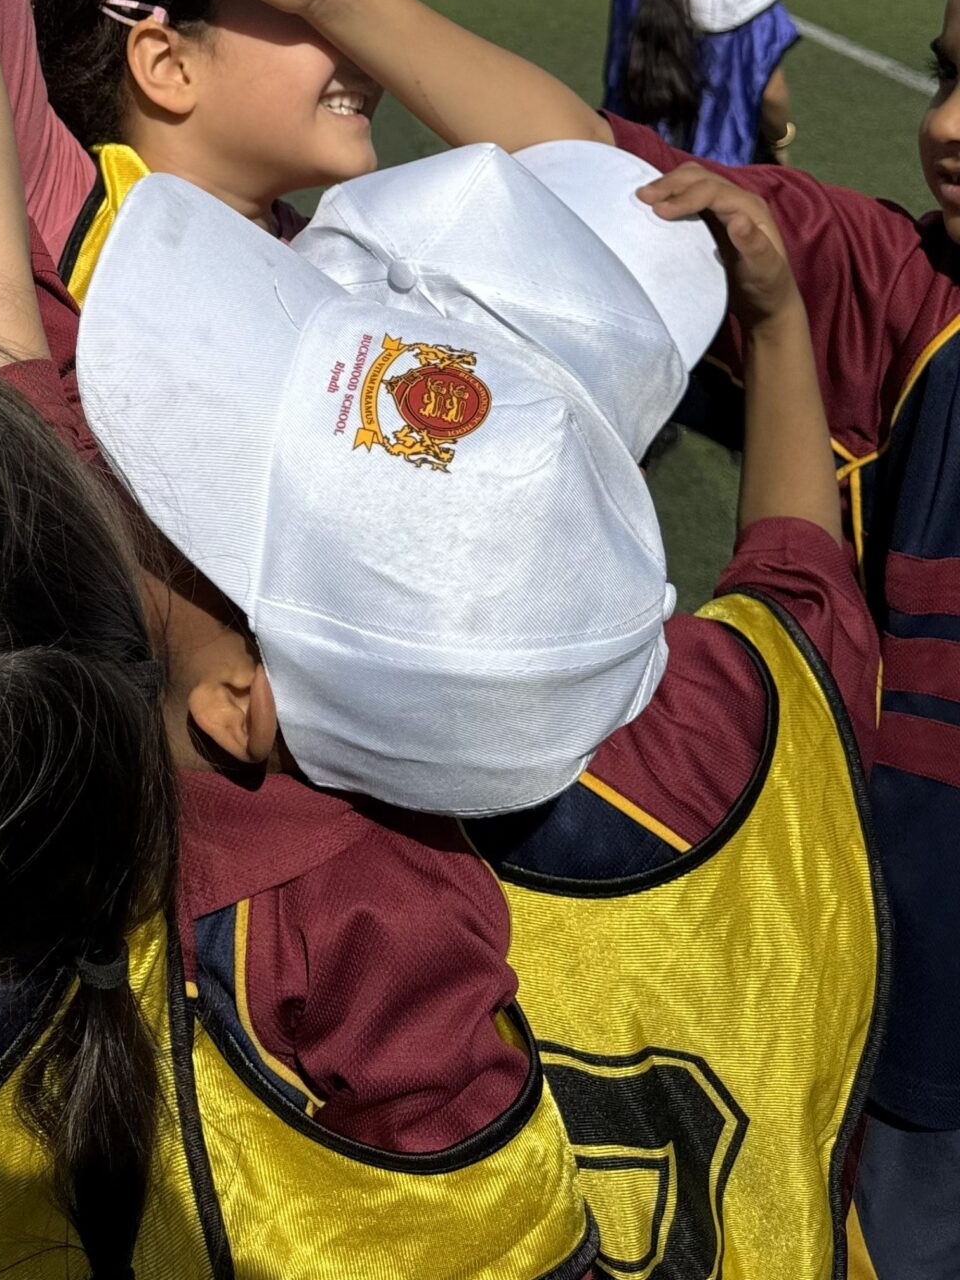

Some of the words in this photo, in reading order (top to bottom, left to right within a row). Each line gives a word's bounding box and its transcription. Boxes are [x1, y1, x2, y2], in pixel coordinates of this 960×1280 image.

[347, 334, 373, 391] BUCKSWOOD
[370, 362, 385, 386] VITAM
[383, 351, 393, 362] AD
[327, 360, 346, 394] Riyadh
[333, 393, 354, 436] SCHOOL
[364, 386, 375, 425] PARAMUS
